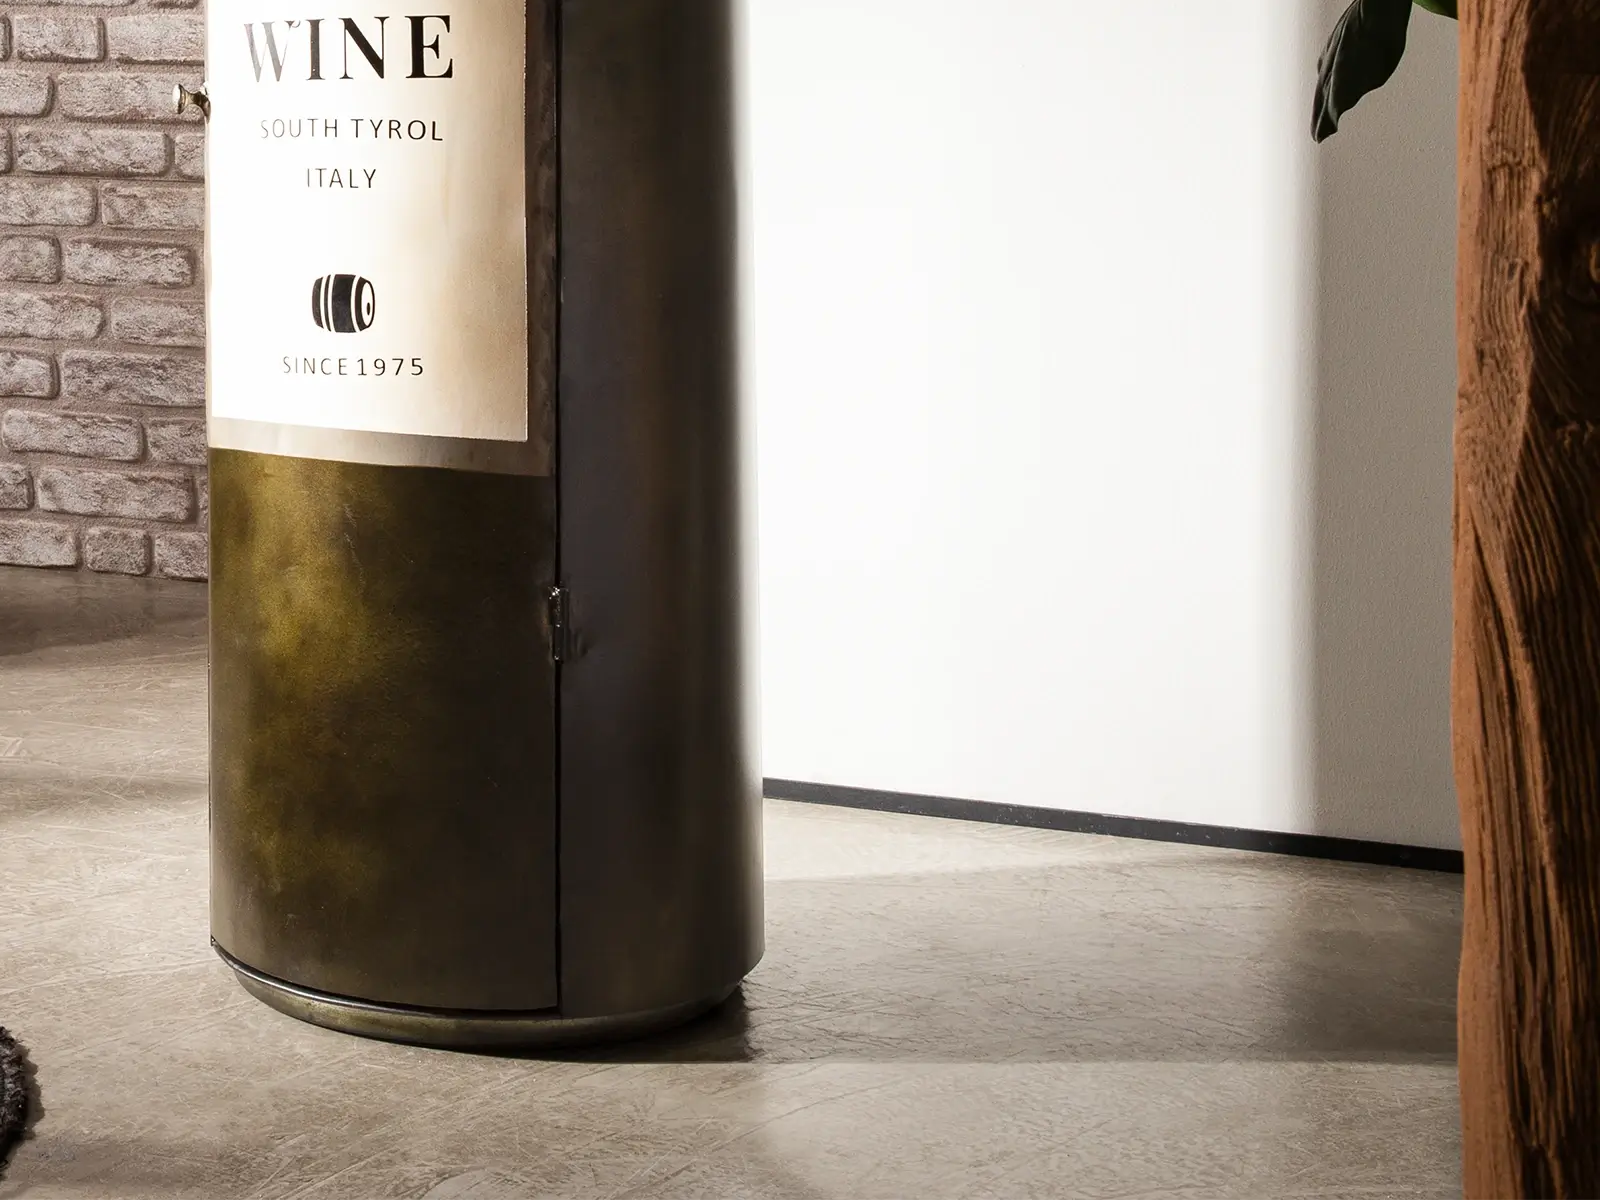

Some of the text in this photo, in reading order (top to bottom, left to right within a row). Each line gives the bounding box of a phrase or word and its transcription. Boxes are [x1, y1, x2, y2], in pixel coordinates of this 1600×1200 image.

[243, 14, 454, 83] WINE
[260, 118, 444, 141] SOUTH TYROL
[306, 167, 377, 189] ITALY
[282, 355, 424, 377] SINCE 1975
